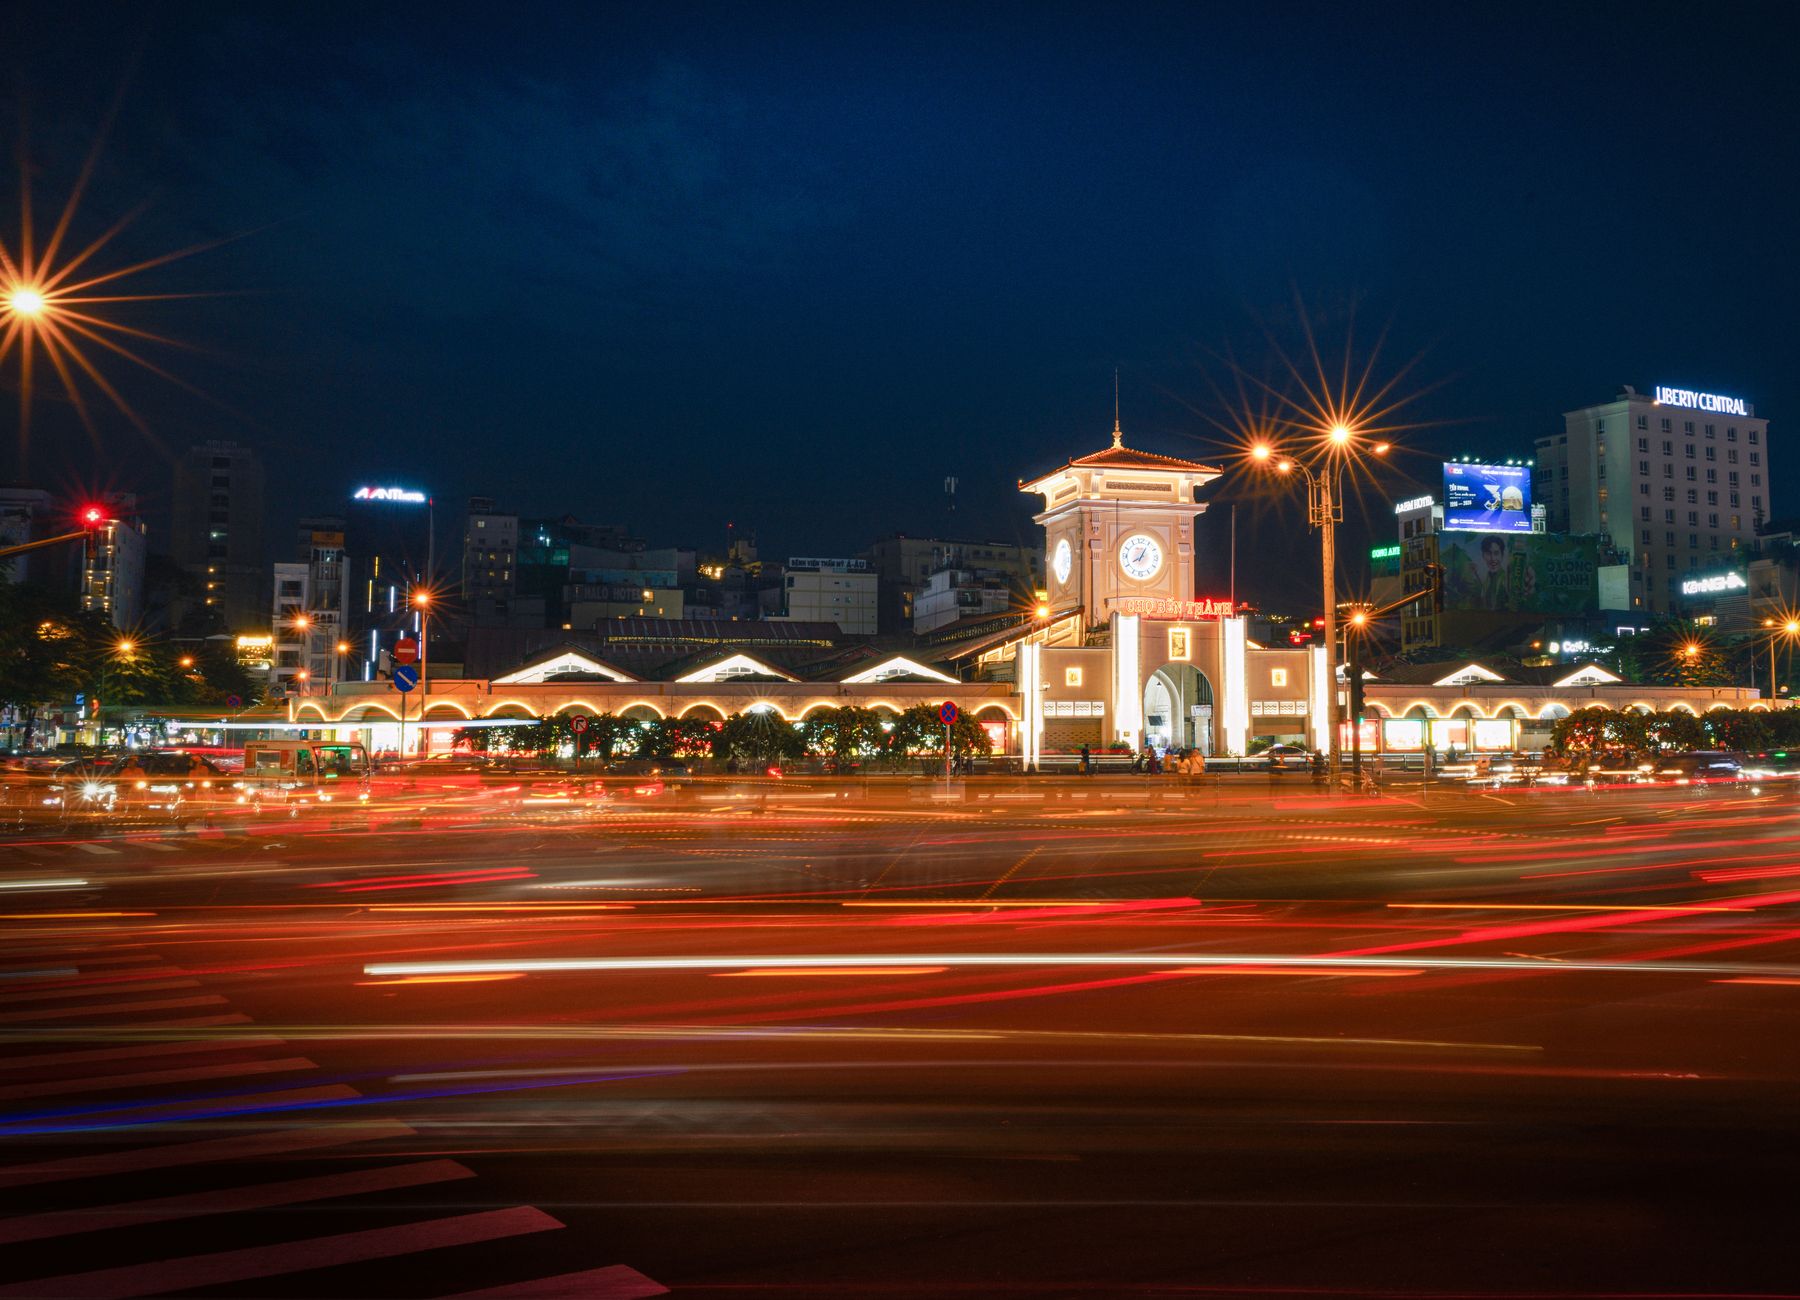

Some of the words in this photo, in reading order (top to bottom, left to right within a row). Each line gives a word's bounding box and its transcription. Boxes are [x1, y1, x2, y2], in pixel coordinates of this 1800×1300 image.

[1656, 386, 1699, 409] LIBERTY
[1698, 393, 1748, 416] CENTRAL
[1127, 599, 1154, 614] CHỢ
[1186, 598, 1233, 616] THÀNH
